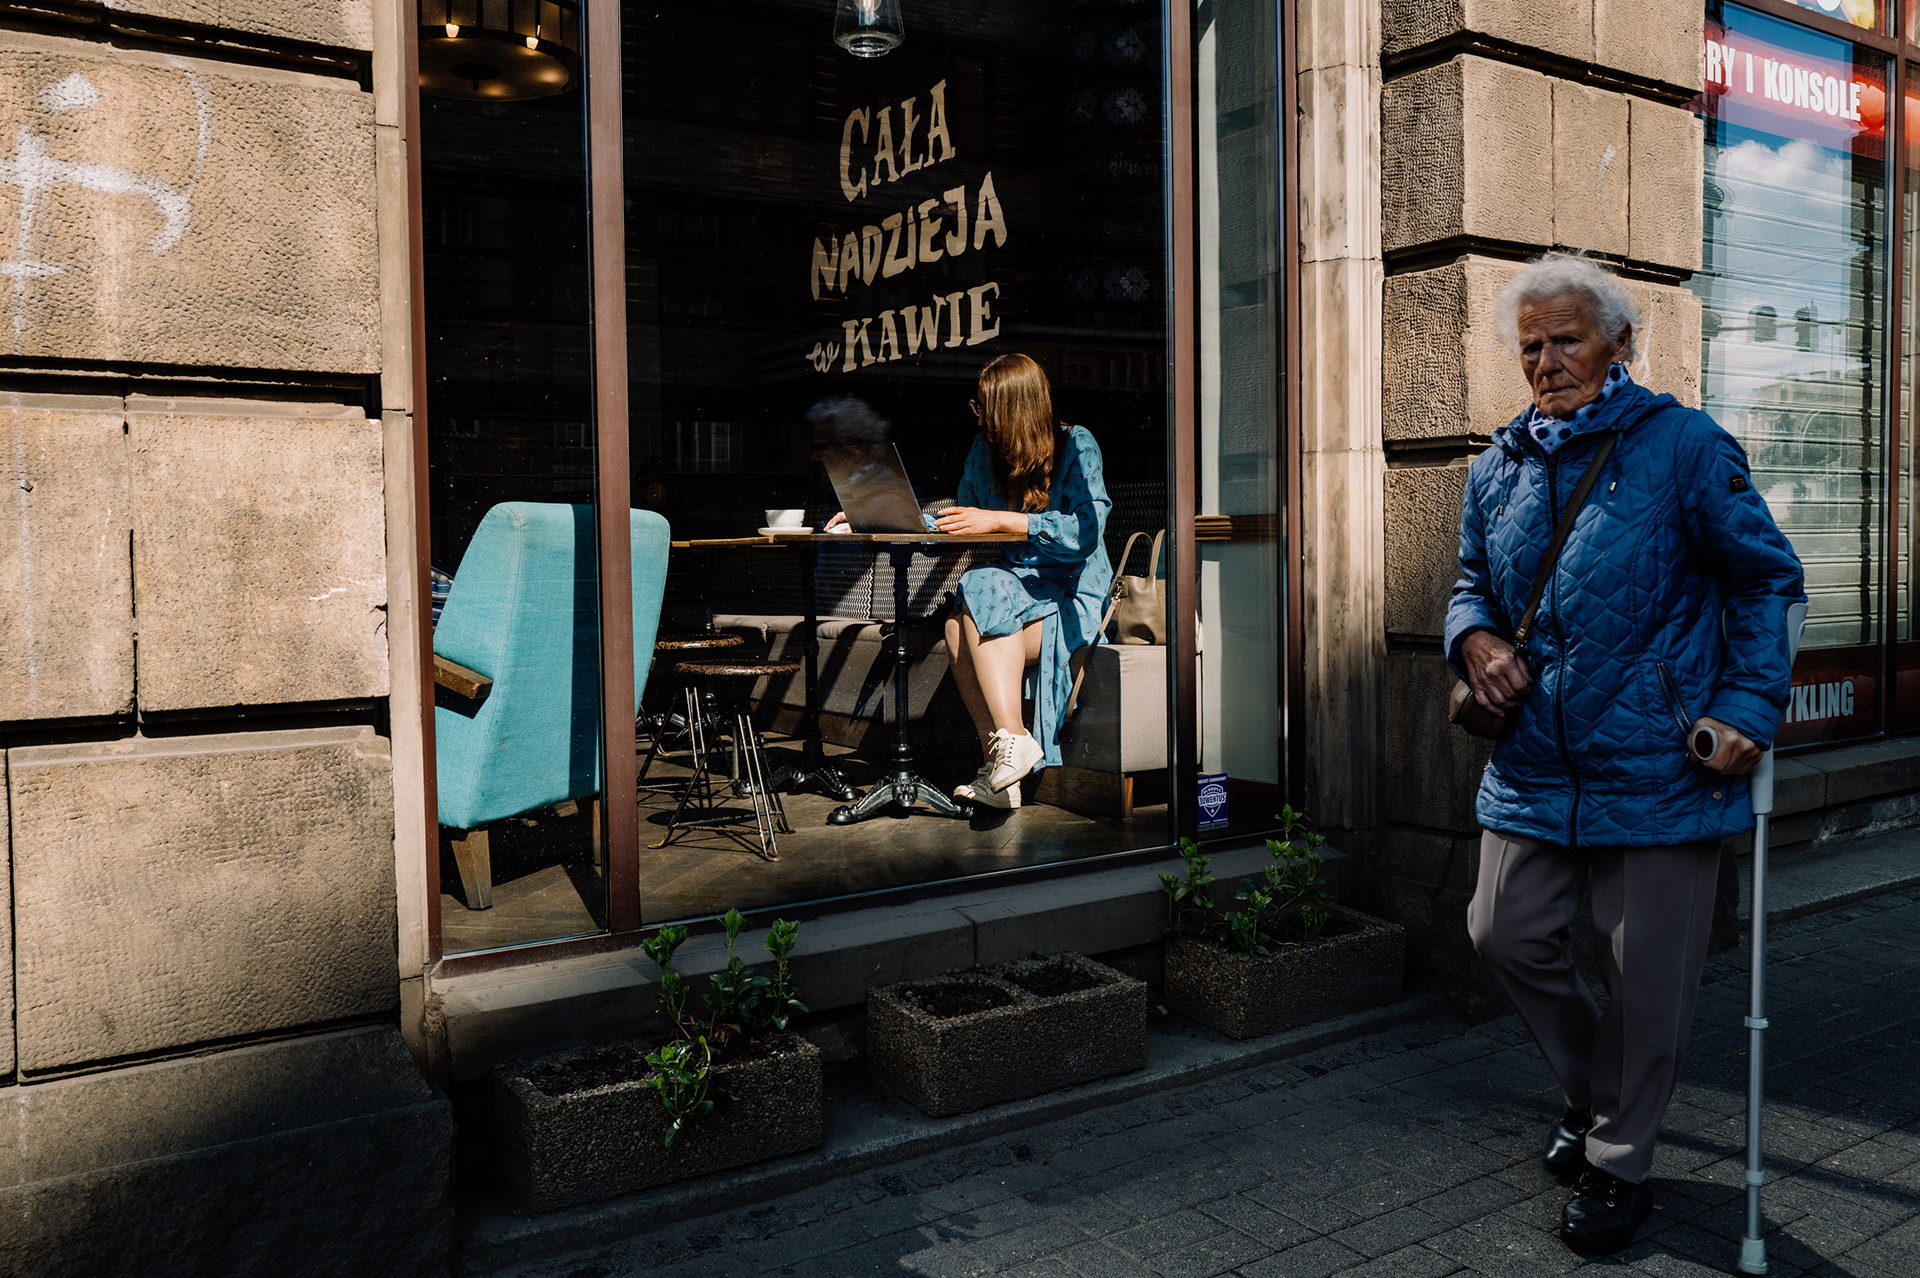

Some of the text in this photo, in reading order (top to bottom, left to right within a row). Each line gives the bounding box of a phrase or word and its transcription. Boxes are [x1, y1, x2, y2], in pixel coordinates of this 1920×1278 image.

[1703, 39, 1861, 121] RY I KONSOLE
[839, 79, 956, 202] CAŁA
[811, 171, 1008, 301] NADZIEJA
[842, 281, 1000, 372] KAWIE
